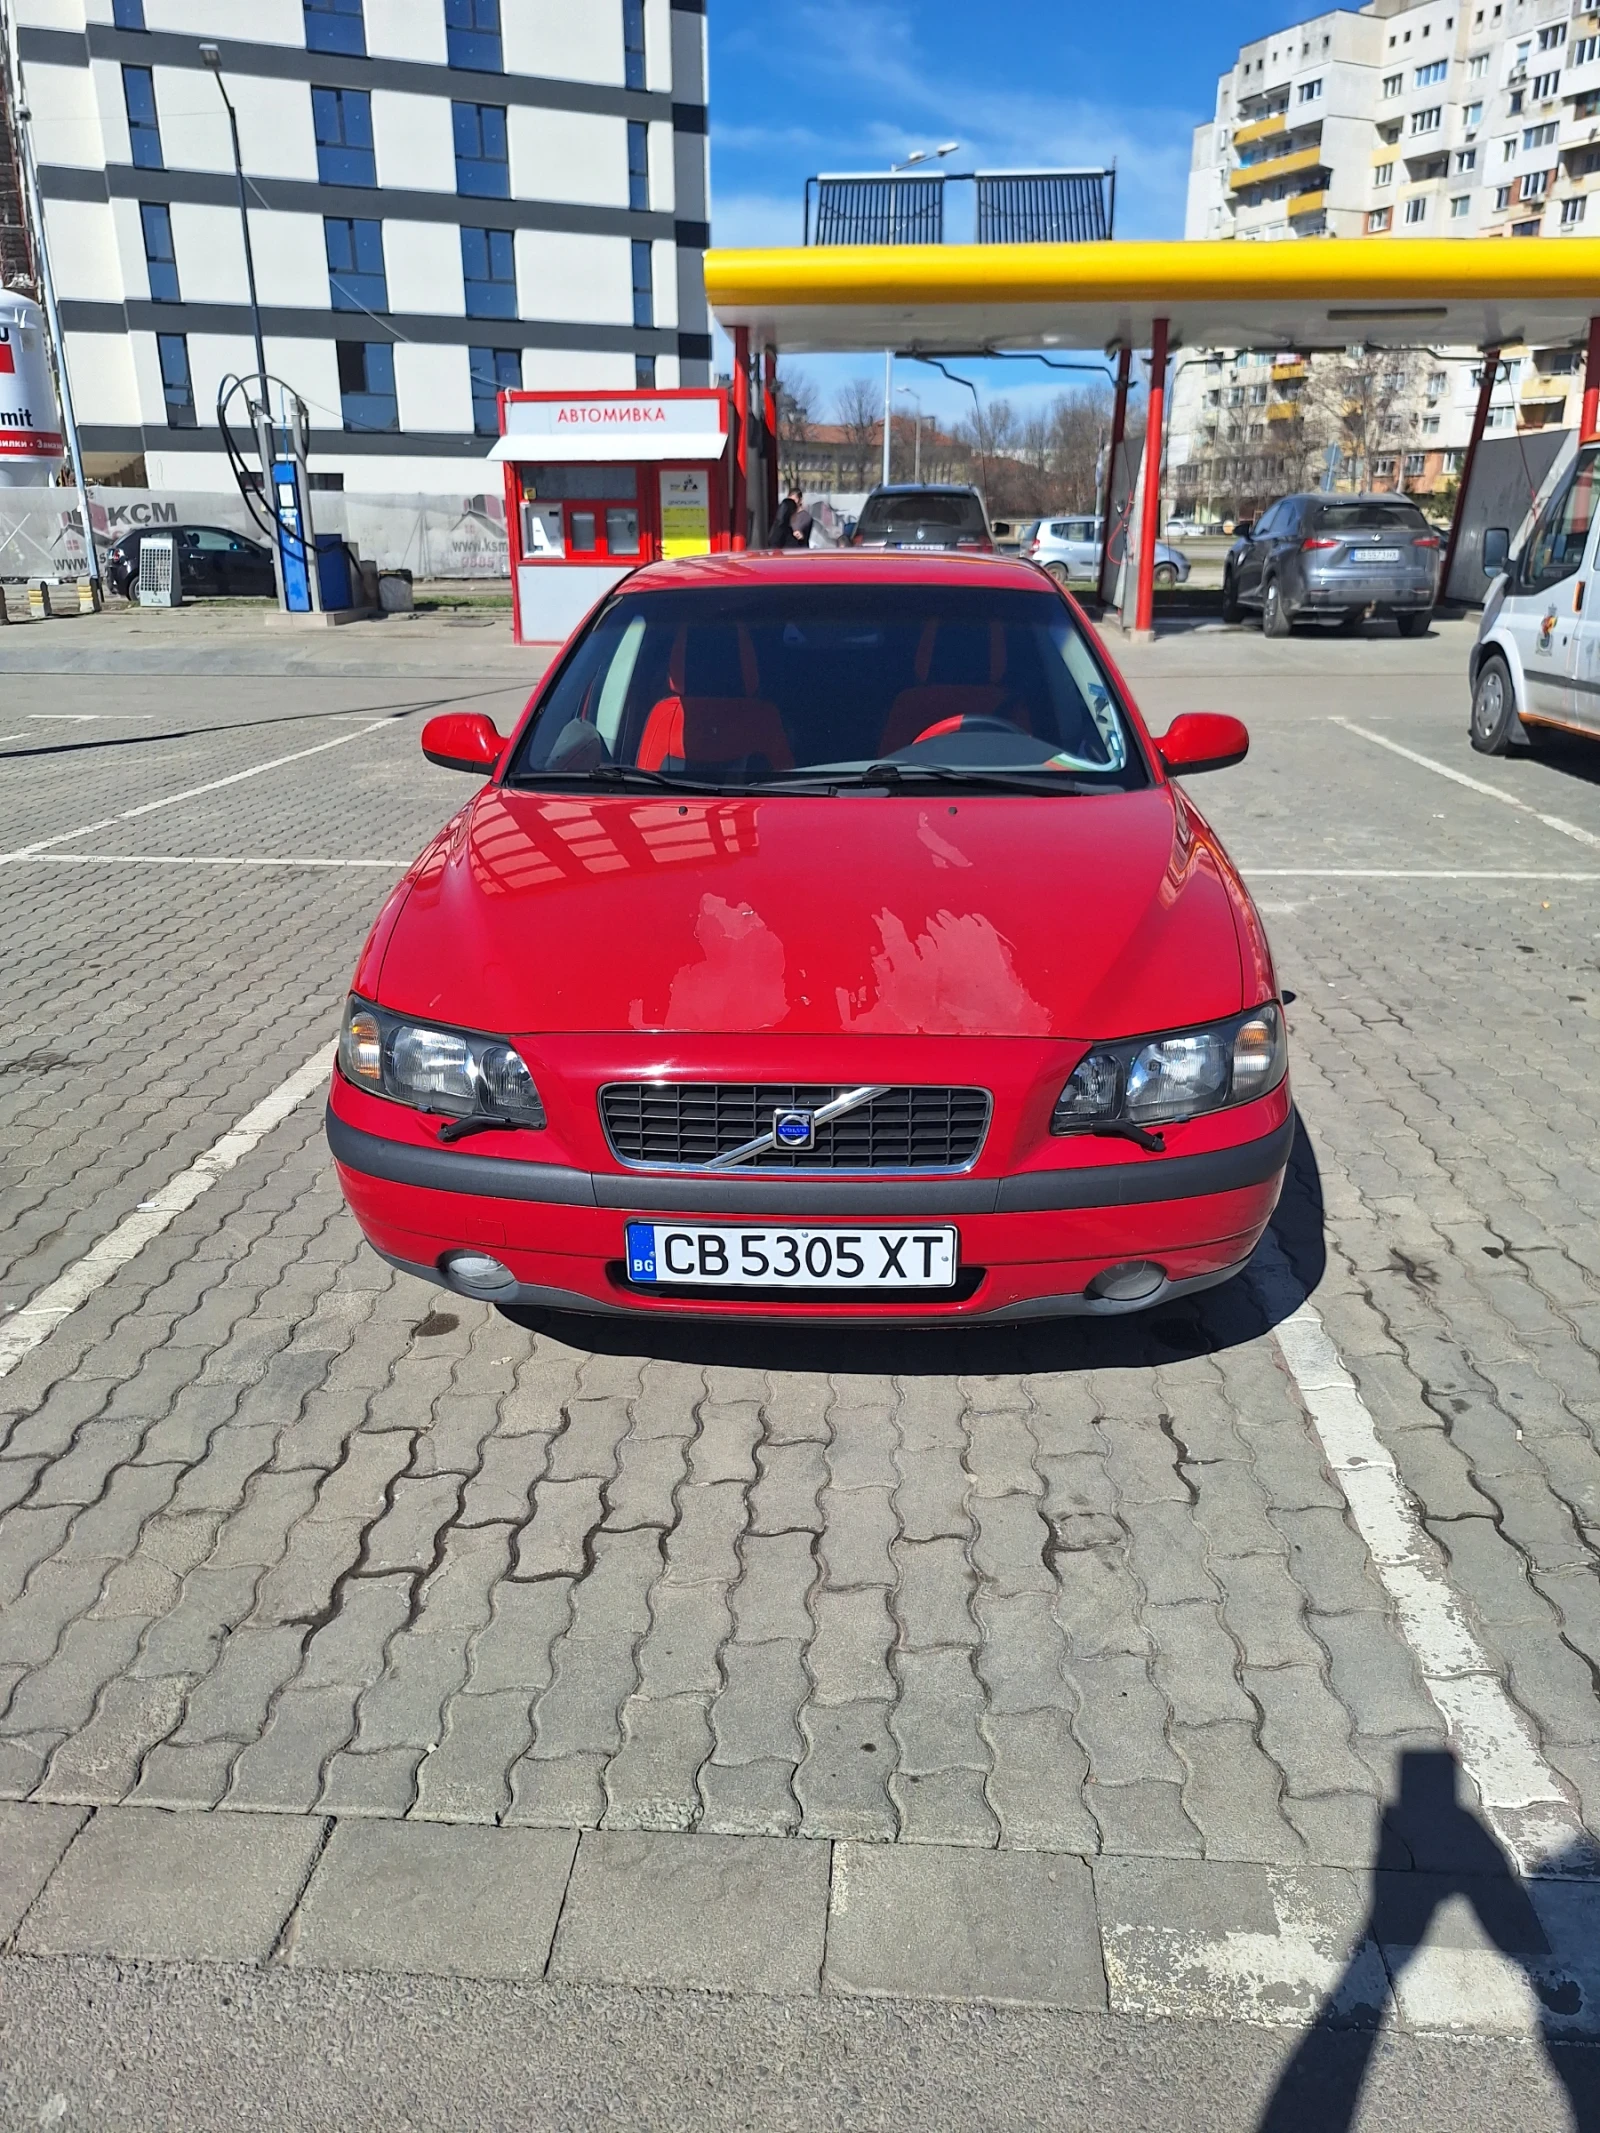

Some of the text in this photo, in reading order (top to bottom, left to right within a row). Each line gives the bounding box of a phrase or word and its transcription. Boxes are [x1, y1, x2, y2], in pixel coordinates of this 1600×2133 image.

[557, 407, 666, 423] АВТОМИВКА
[664, 1233, 943, 1278] CB 5305 XT
[633, 1259, 654, 1272] BG
